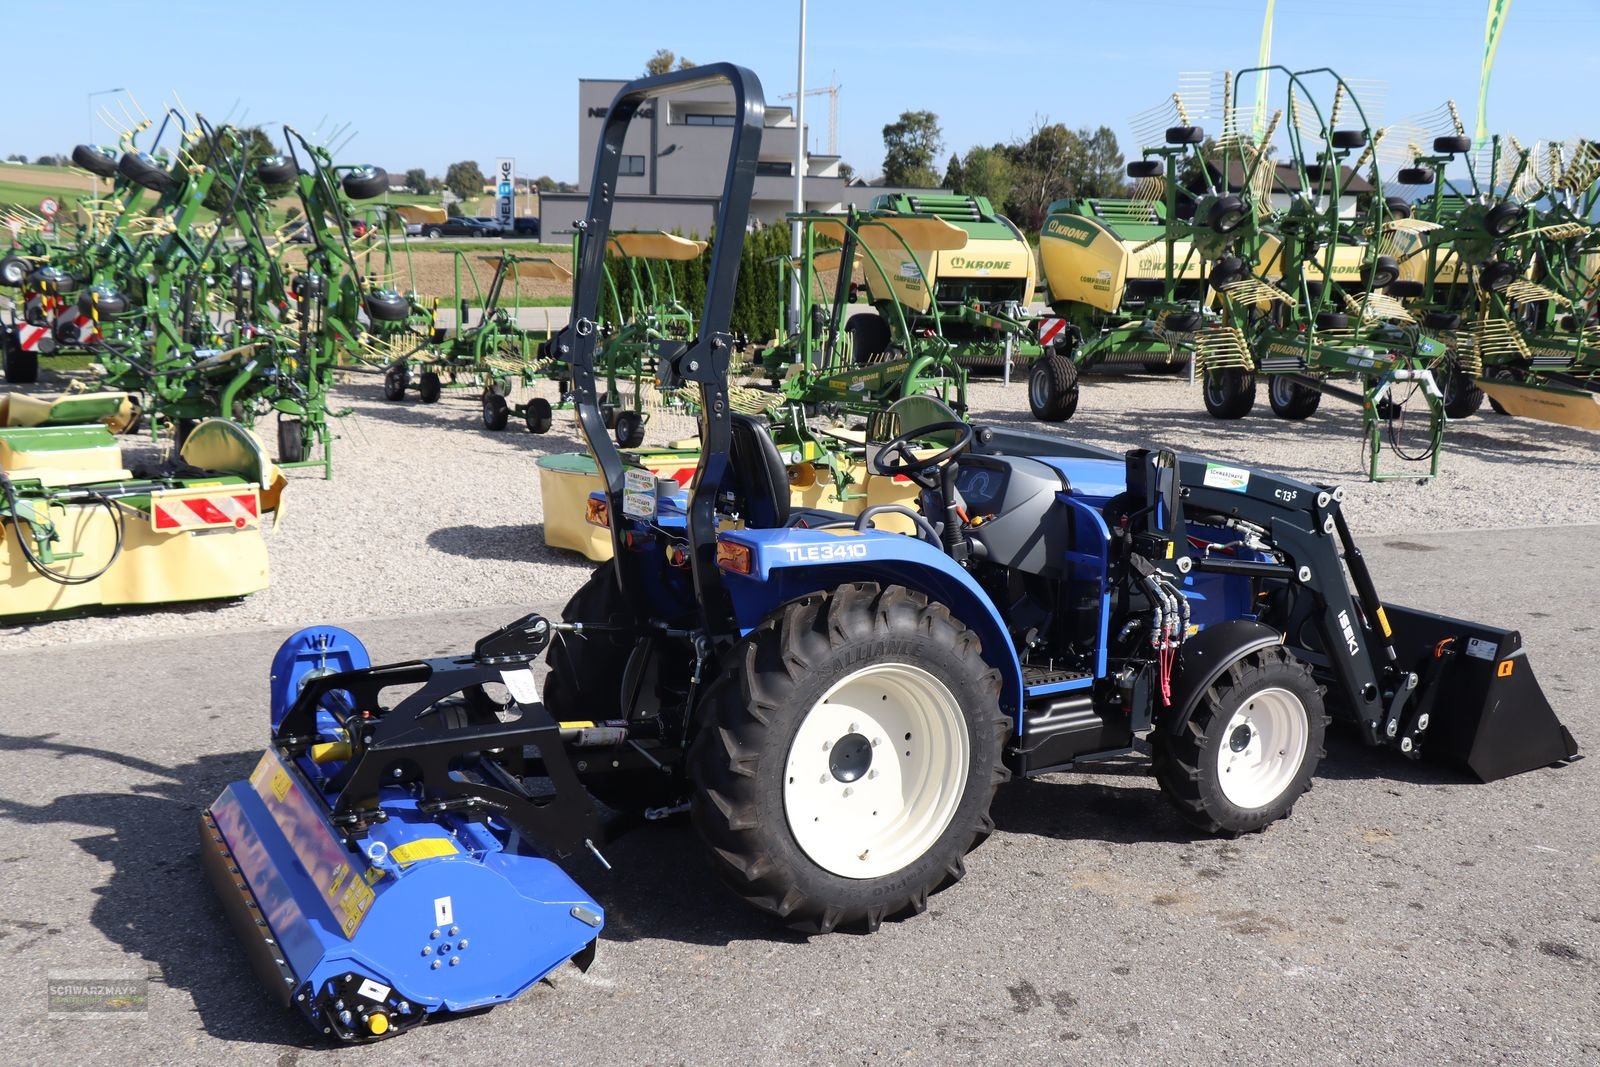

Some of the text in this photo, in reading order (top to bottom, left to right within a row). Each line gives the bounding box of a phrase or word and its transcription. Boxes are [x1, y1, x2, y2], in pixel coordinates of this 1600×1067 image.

[1056, 225, 1089, 241] KRONE
[965, 260, 1012, 269] KRONE
[786, 543, 867, 561] TLE3410
[1337, 609, 1360, 656] ISEKI
[832, 639, 923, 676] ALLIANCE
